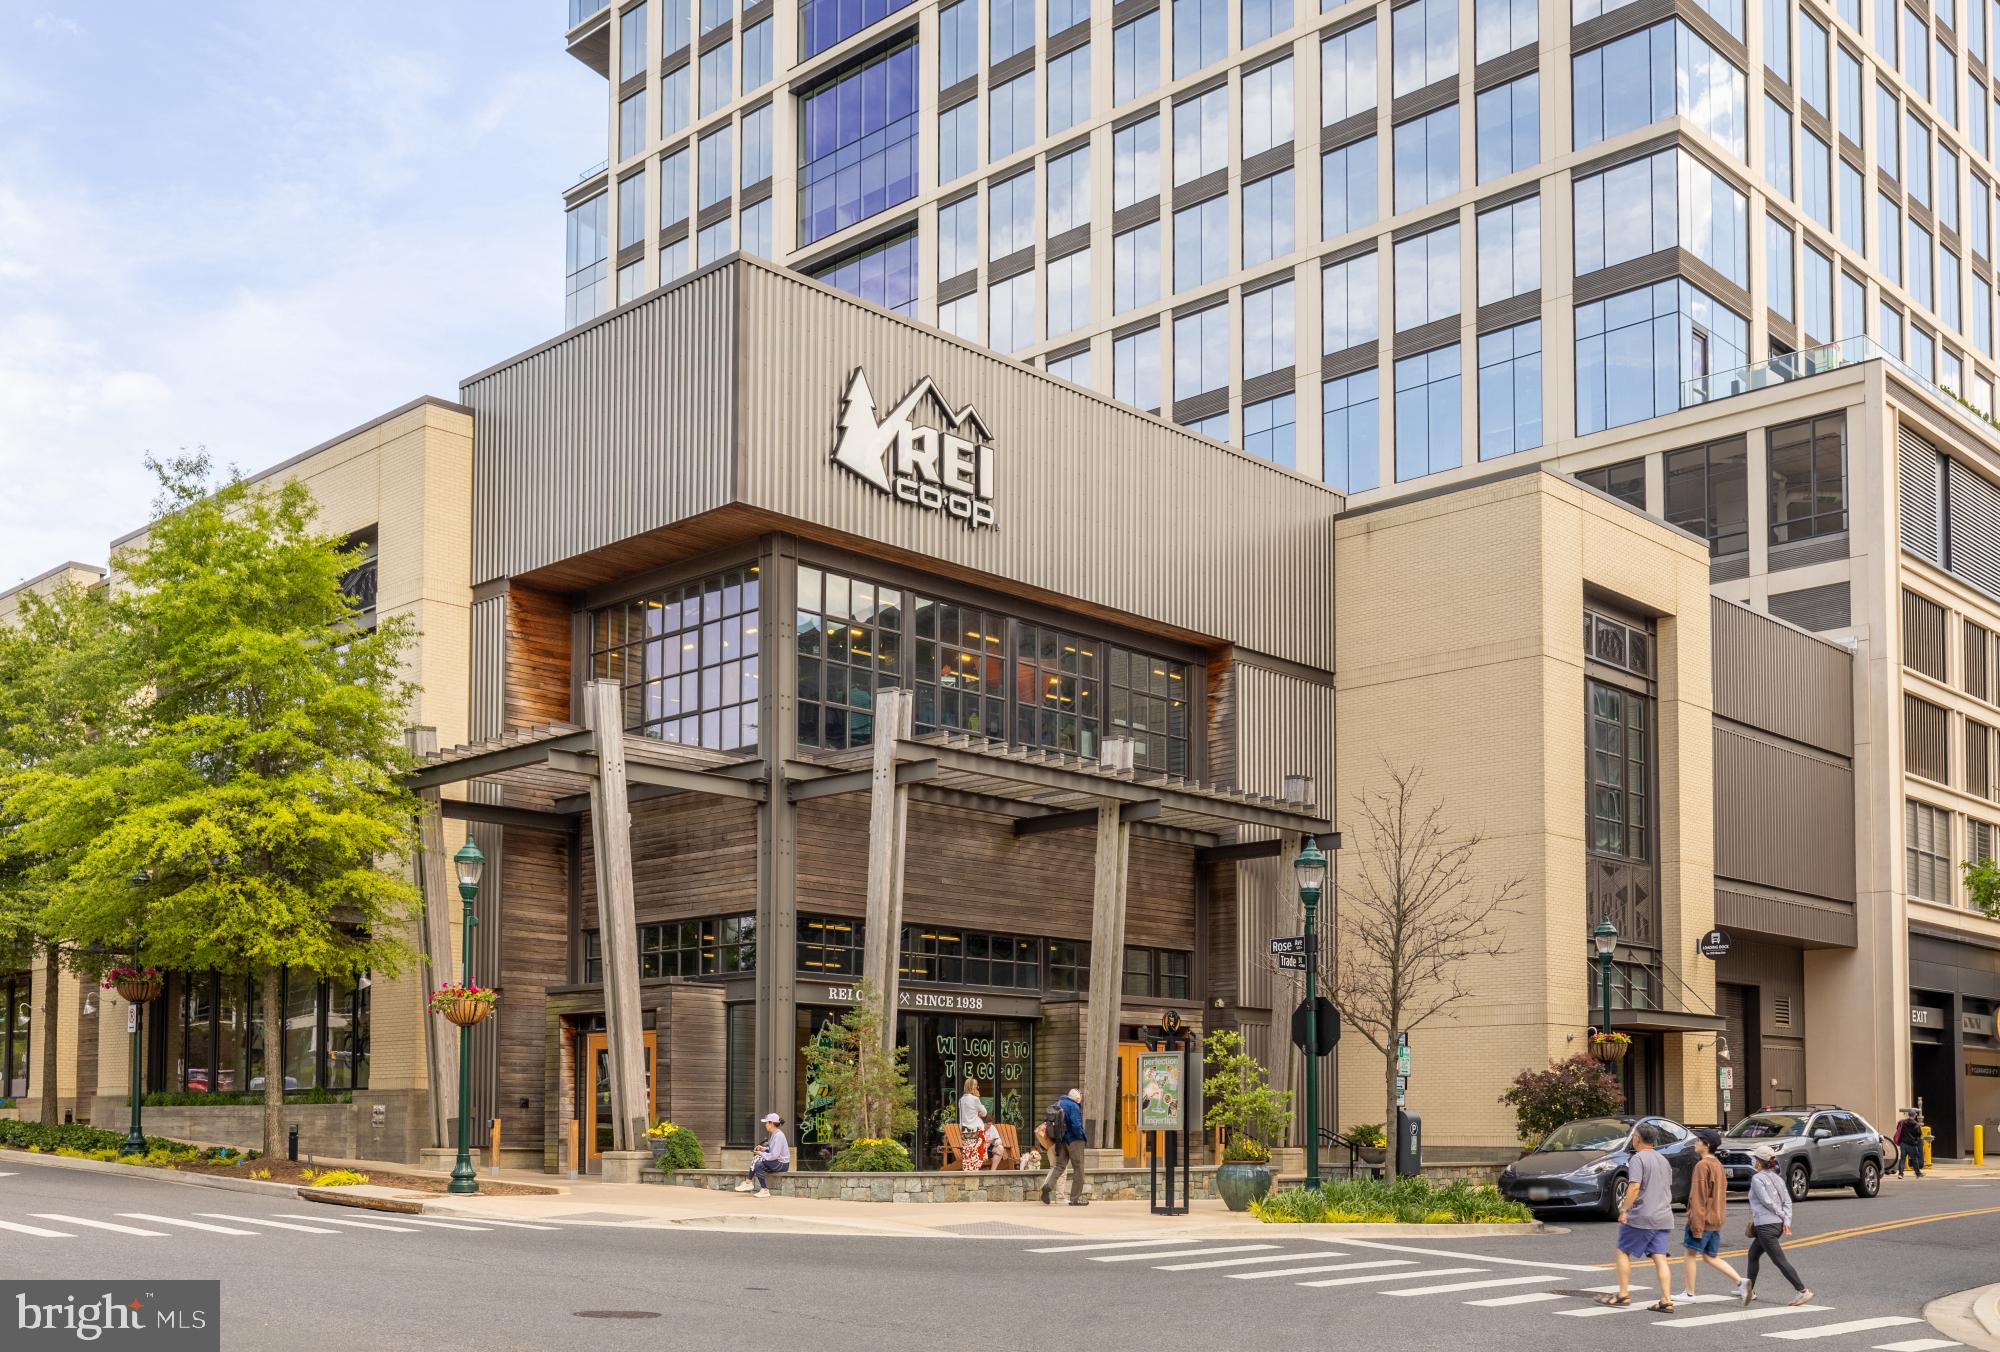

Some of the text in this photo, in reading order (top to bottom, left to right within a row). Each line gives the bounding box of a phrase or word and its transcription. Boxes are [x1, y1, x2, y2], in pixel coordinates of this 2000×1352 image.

[895, 422, 994, 500] REI
[1272, 941, 1292, 952] Rose
[1280, 955, 1297, 967] Trade
[828, 987, 853, 1000] REI
[915, 993, 983, 1010] SINCE 1938
[1911, 1010, 1928, 1023] EXIT
[1013, 1041, 1030, 1058] TO
[944, 1060, 974, 1078] TE
